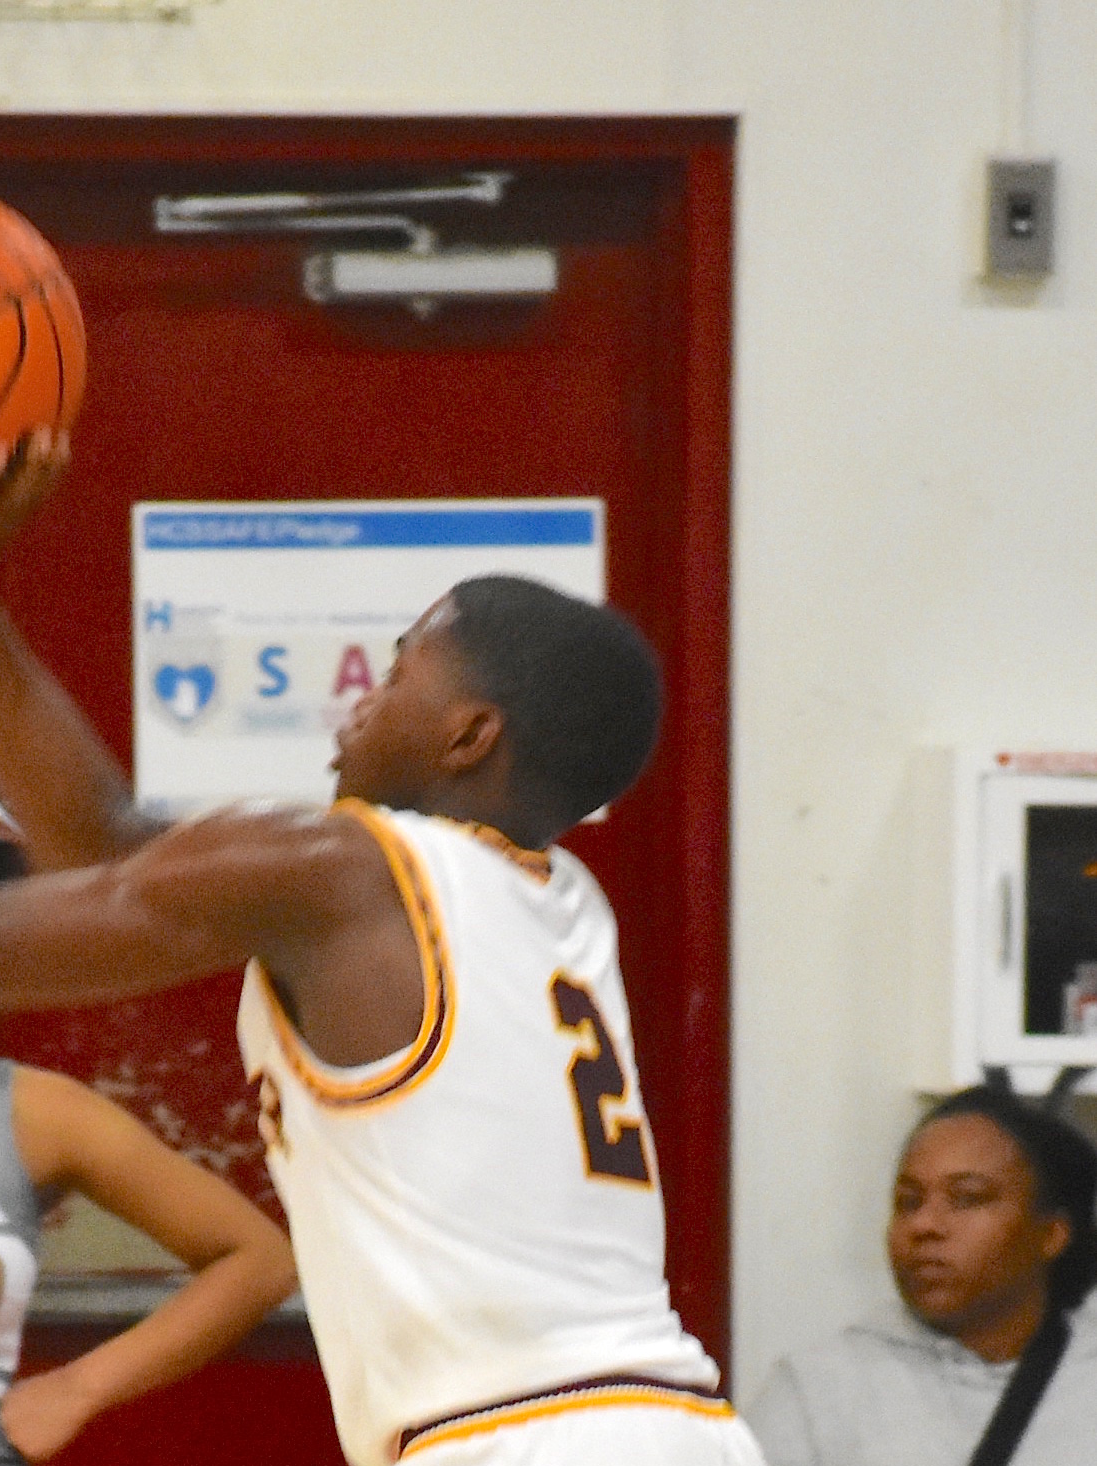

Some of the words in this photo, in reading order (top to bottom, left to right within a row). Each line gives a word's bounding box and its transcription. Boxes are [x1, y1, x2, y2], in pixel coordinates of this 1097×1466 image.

[258, 645, 289, 697] S
[333, 644, 374, 697] A
[549, 968, 656, 1190] 2
